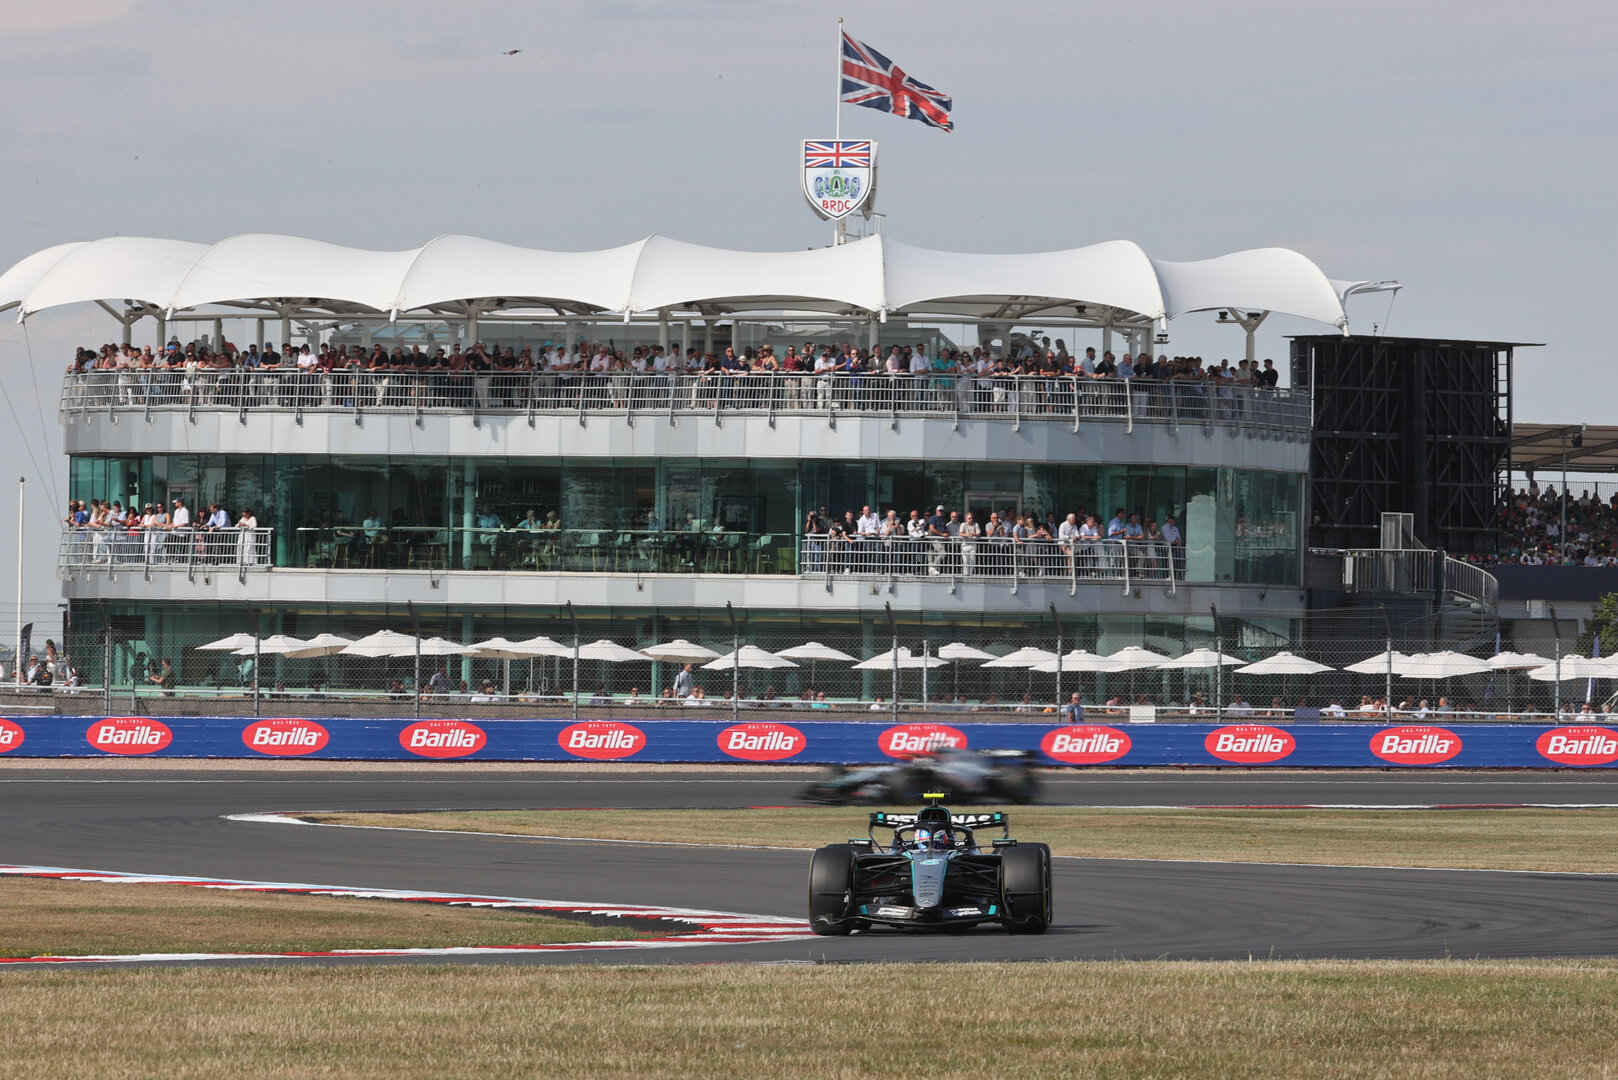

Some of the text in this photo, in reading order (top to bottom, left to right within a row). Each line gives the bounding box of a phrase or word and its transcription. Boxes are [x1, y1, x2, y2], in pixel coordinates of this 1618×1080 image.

[822, 199, 851, 213] BRDC
[97, 726, 161, 745] Barilla
[253, 727, 317, 746] Barilla
[410, 729, 476, 748] Barilla
[568, 730, 634, 749] Barilla
[727, 732, 794, 751] Barilla
[1051, 734, 1121, 753] Barilla
[1215, 734, 1284, 753] Barilla
[1381, 735, 1450, 754] Barilla
[1547, 736, 1617, 755] Barilla
